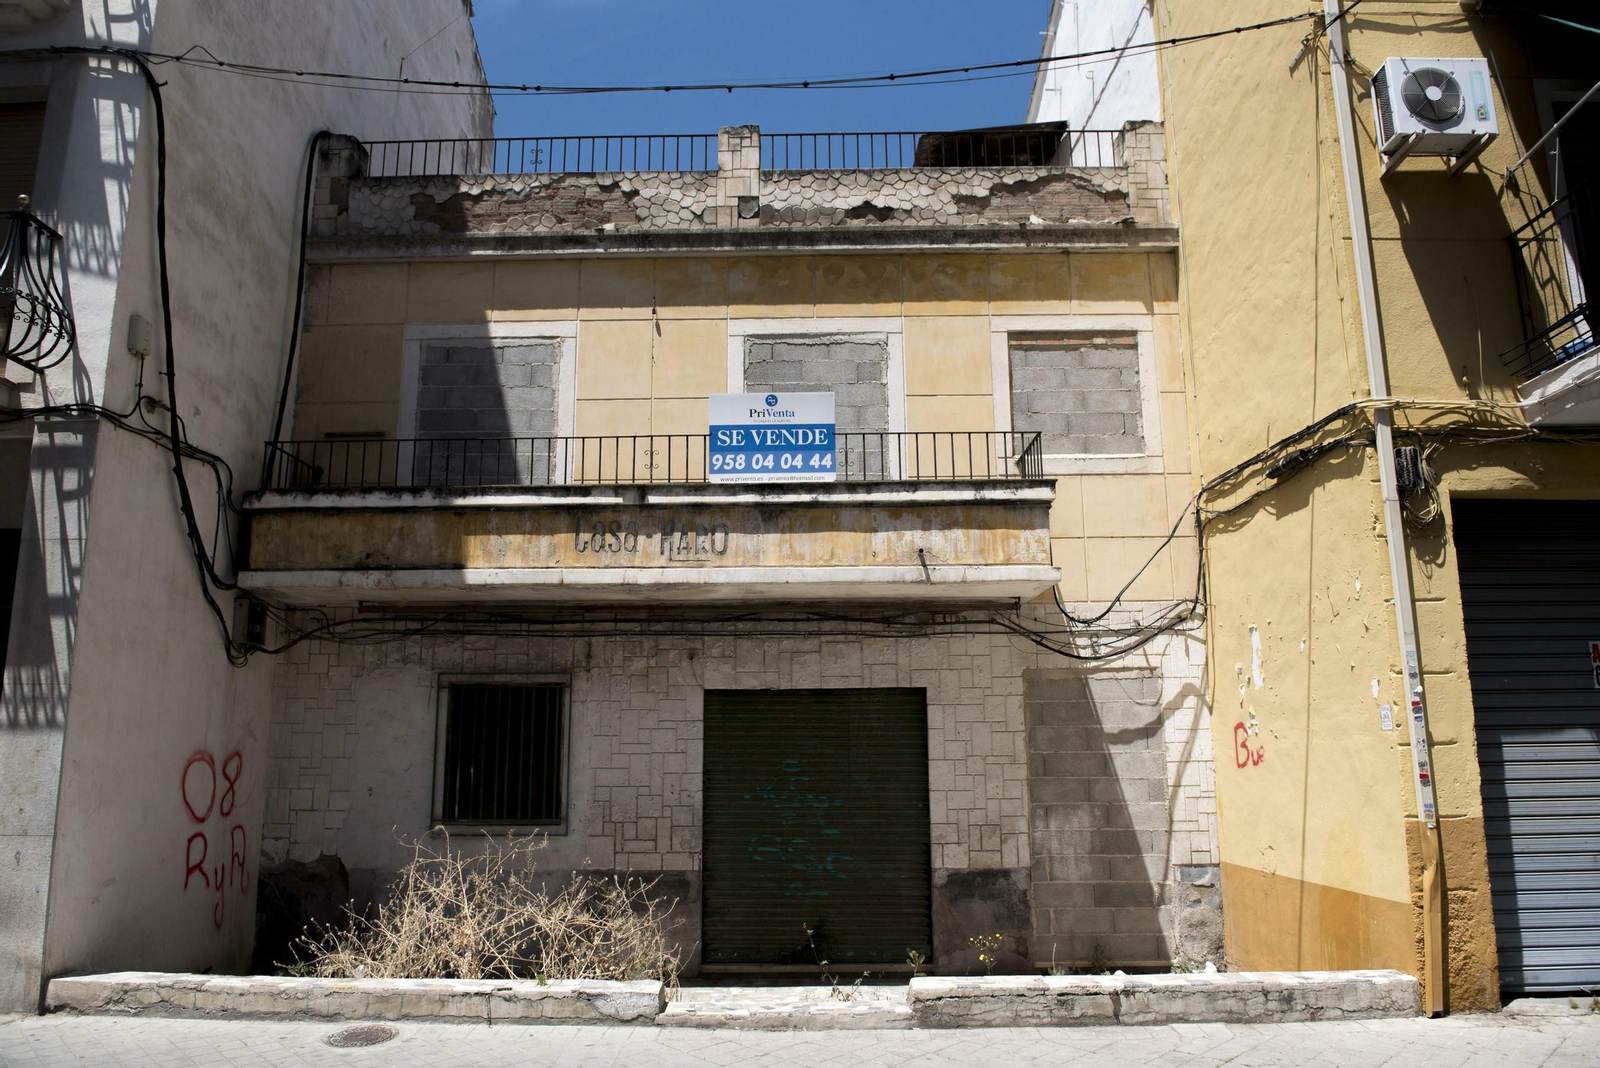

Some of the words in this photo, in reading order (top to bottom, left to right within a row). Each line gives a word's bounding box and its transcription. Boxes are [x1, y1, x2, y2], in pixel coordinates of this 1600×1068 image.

[749, 408, 795, 418] PriVenta
[717, 429, 746, 446] SE
[750, 428, 829, 446] VENDE
[712, 454, 746, 471] 958
[751, 453, 775, 470] 04
[780, 453, 803, 470] 04
[809, 453, 833, 469] 44
